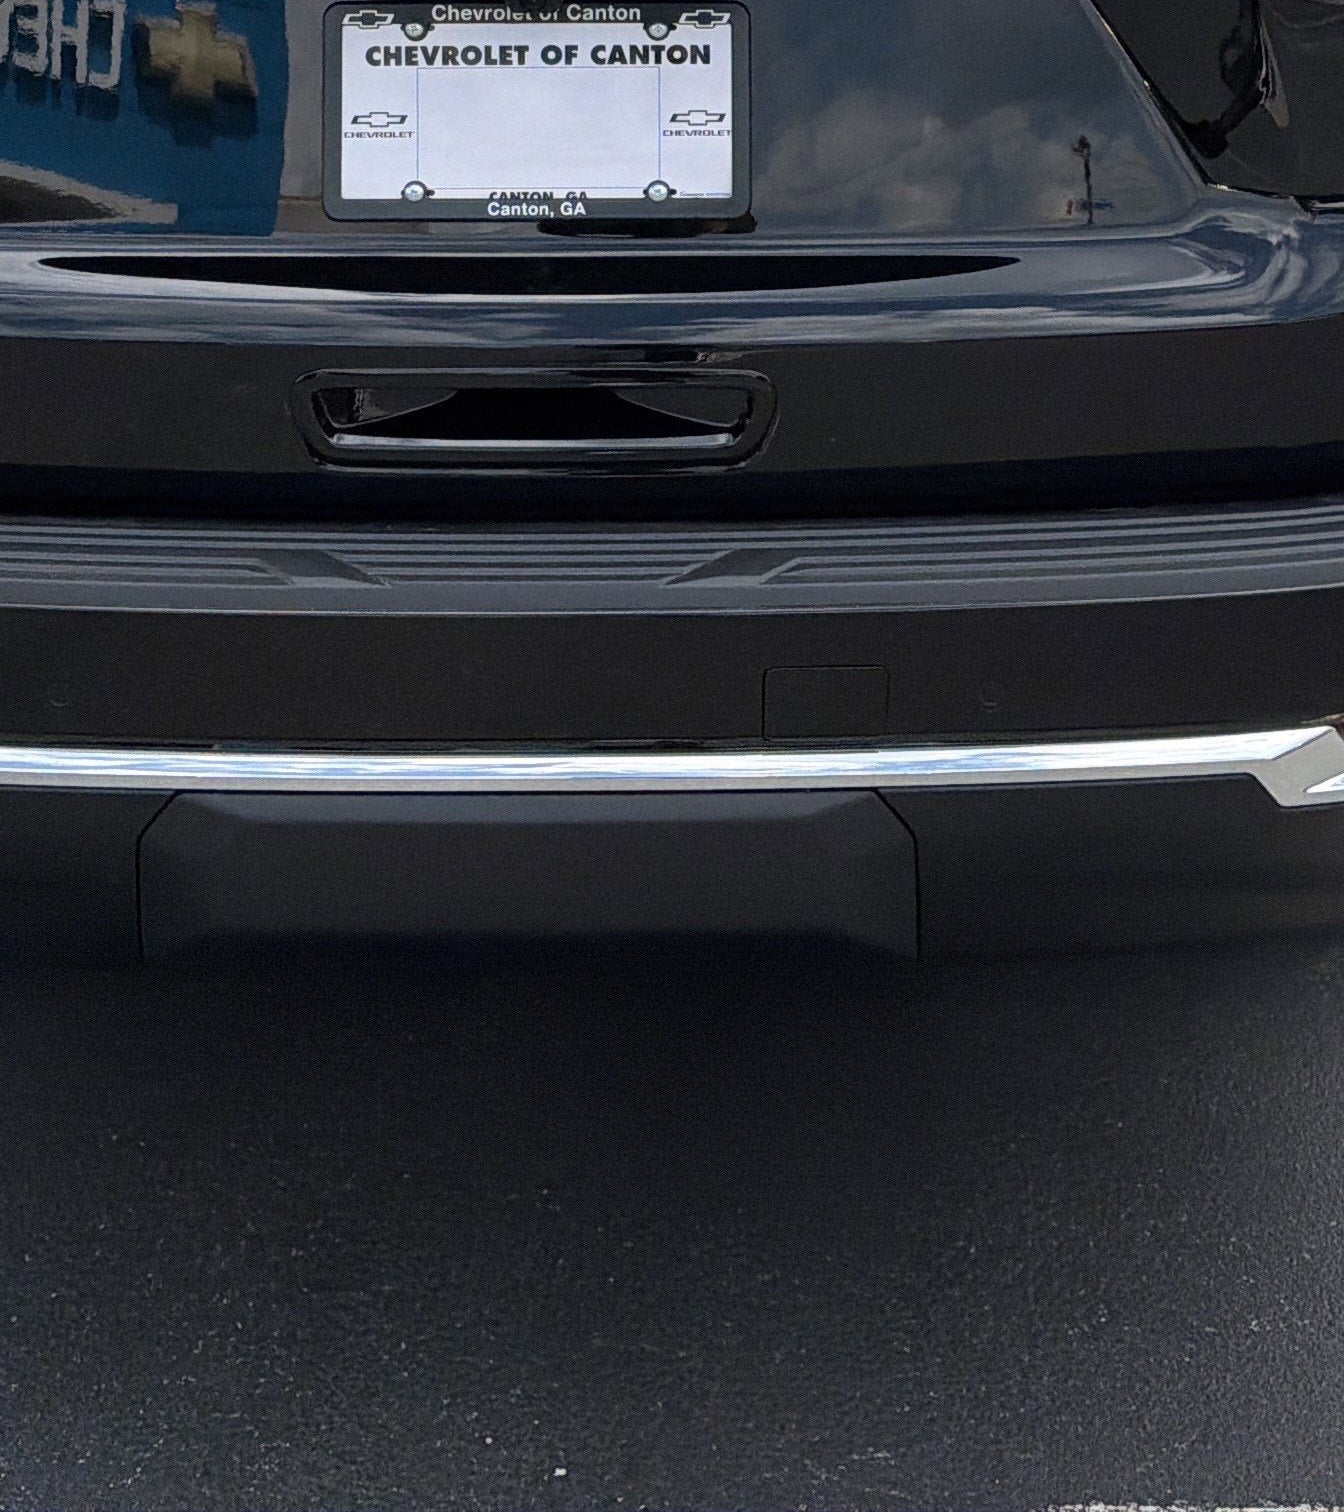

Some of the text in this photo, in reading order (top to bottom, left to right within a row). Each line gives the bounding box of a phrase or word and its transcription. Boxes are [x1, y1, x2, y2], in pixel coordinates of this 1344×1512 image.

[566, 3, 641, 21] Canton
[365, 43, 711, 67] CHEVROLET OF CANTON
[343, 130, 415, 139] CHEVROLET
[662, 129, 732, 137] CHEVROLET
[487, 201, 587, 218] Canton, GA
